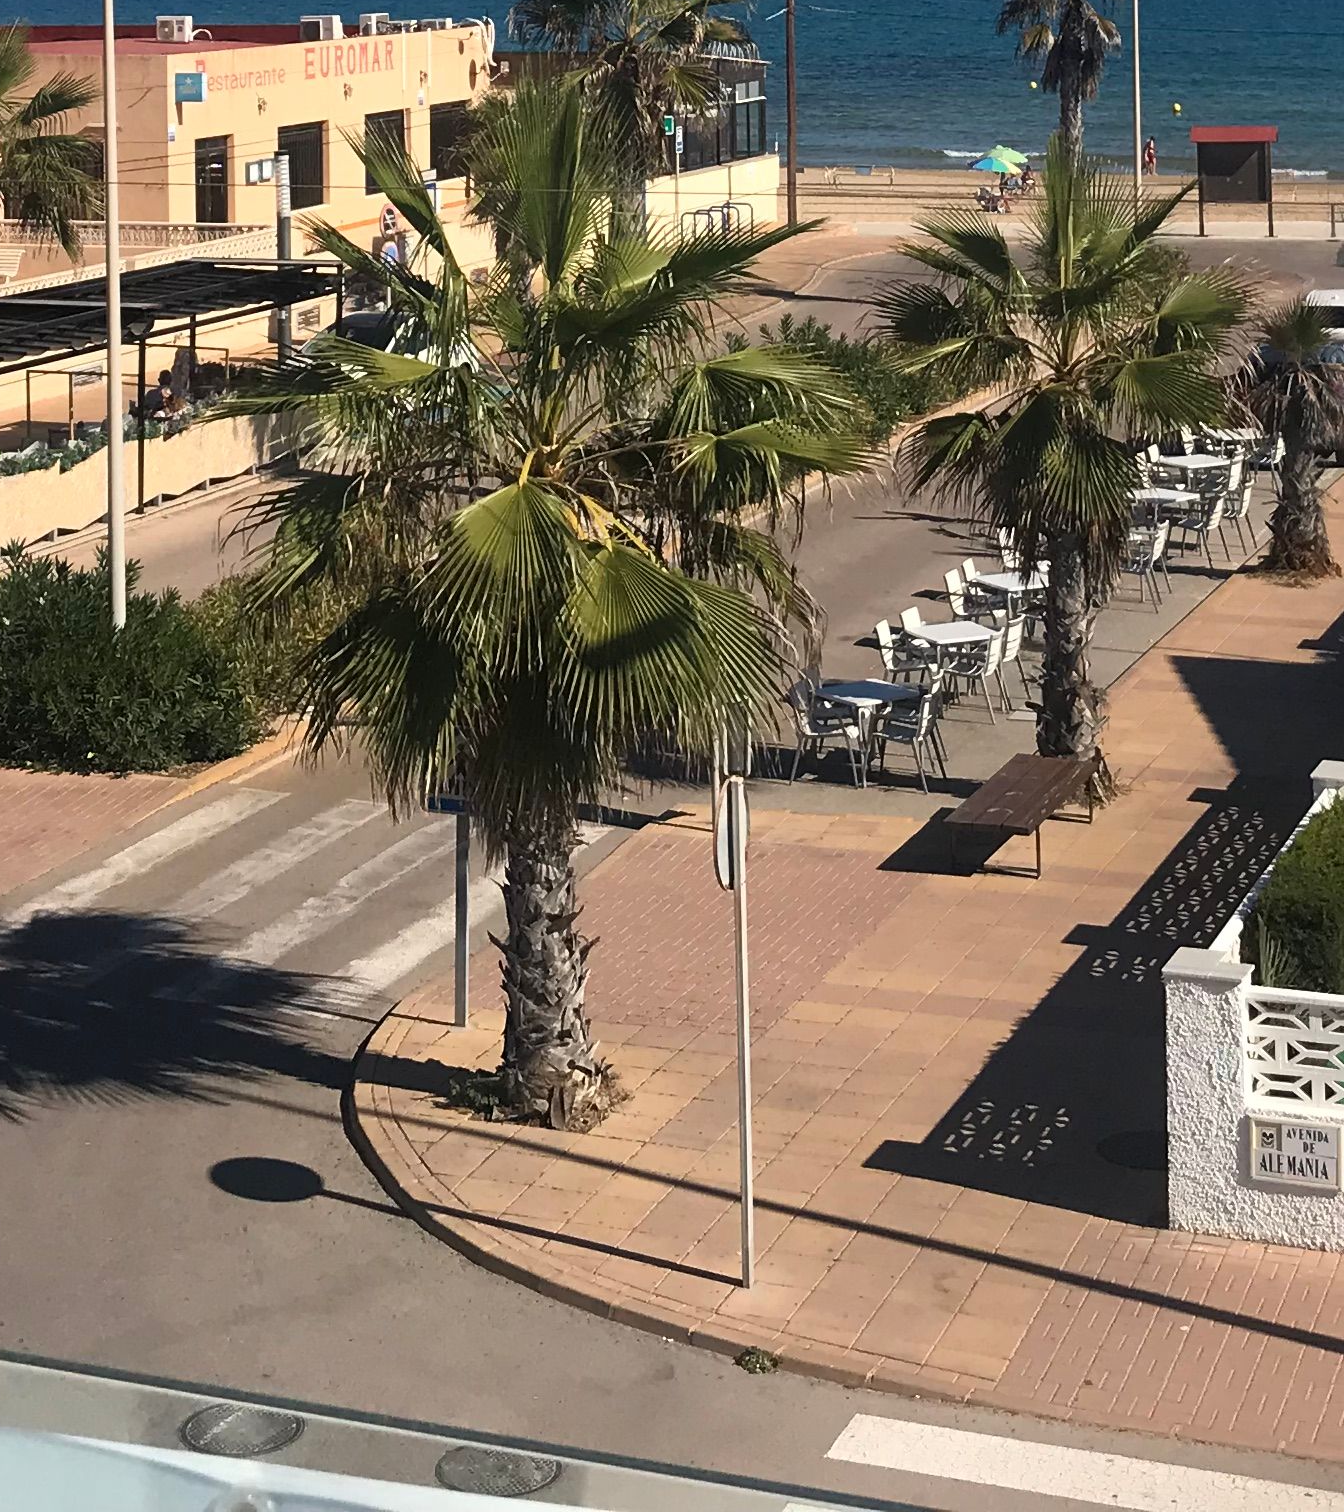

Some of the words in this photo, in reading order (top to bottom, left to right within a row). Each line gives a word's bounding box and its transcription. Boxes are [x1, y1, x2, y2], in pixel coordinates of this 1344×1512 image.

[304, 40, 394, 80] EUROMAR
[1286, 1127, 1329, 1143] AVENIDA
[1302, 1141, 1316, 1154] DE
[1259, 1153, 1329, 1180] ALEMANIA
